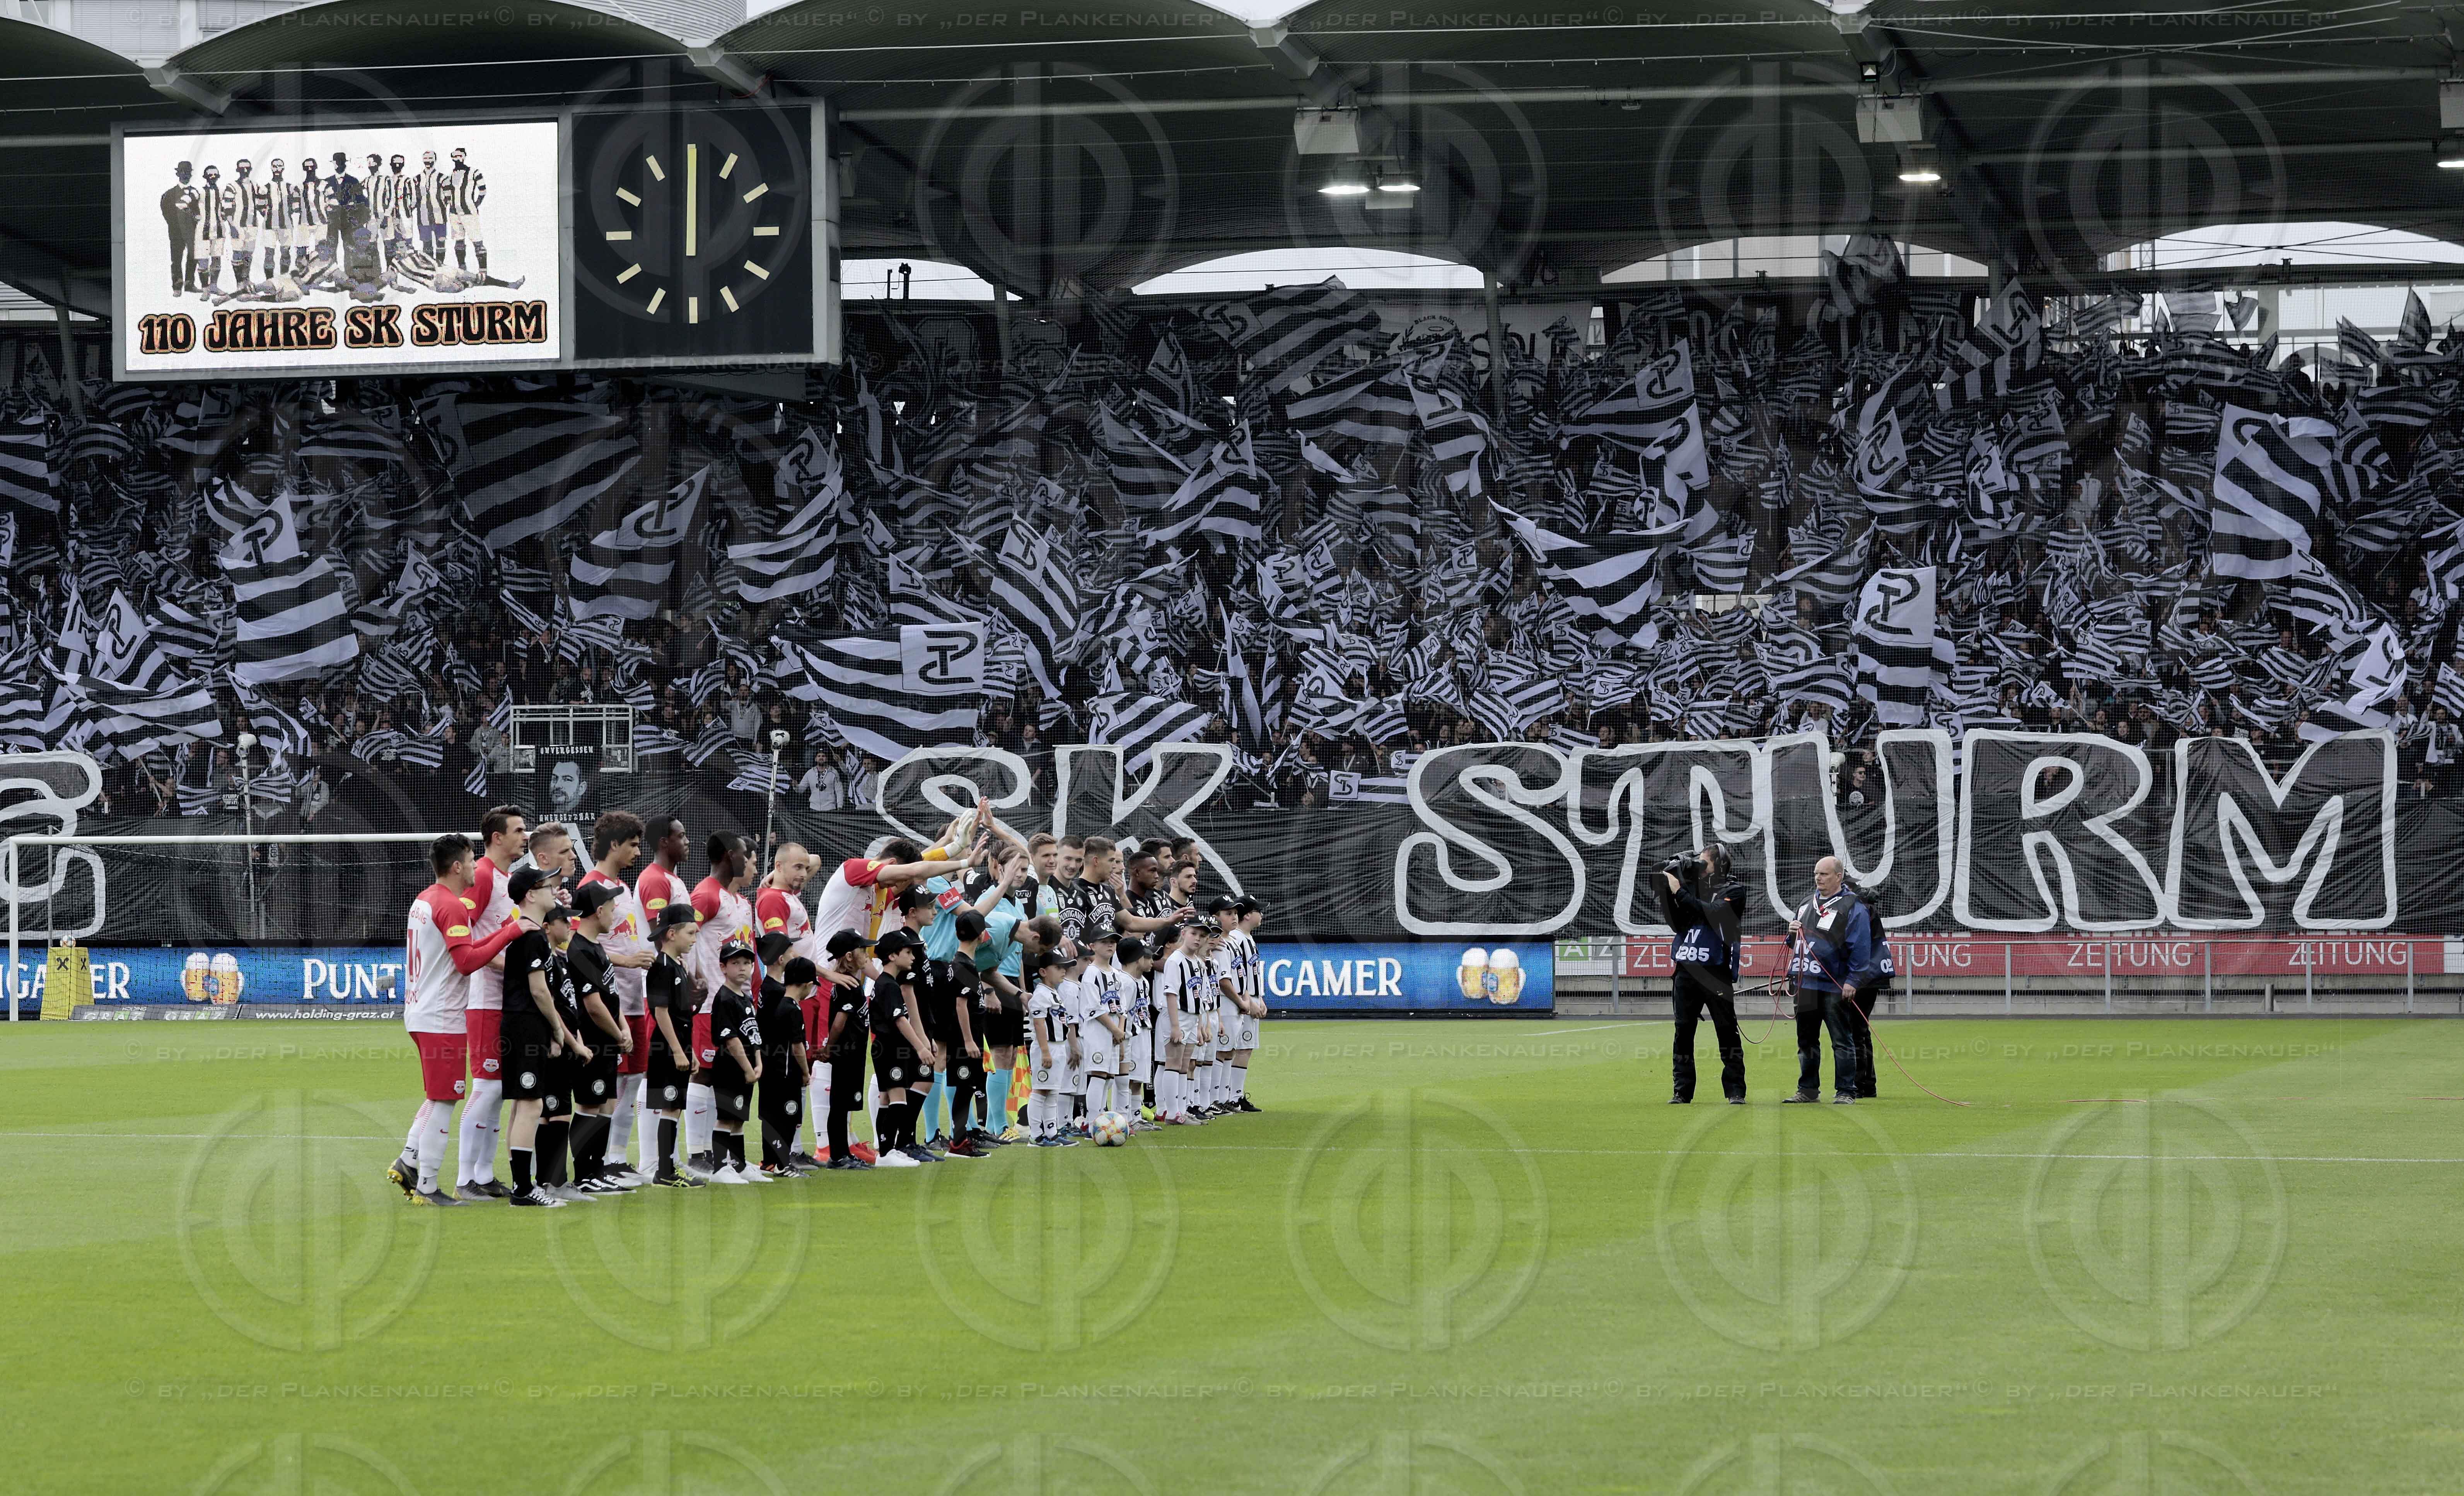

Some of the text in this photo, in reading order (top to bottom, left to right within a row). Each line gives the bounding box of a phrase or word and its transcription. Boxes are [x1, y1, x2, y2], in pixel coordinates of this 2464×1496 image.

[140, 301, 548, 354] 110 JAHRE SK STURM
[540, 746, 593, 754] UNVERGESSEN
[1395, 728, 2397, 935] STURM
[1059, 910, 1085, 926] PUNTIGAMER
[1684, 929, 1701, 944] TV
[1795, 940, 1815, 955] TV
[255, 1008, 395, 1021] www.holding-graz.at
